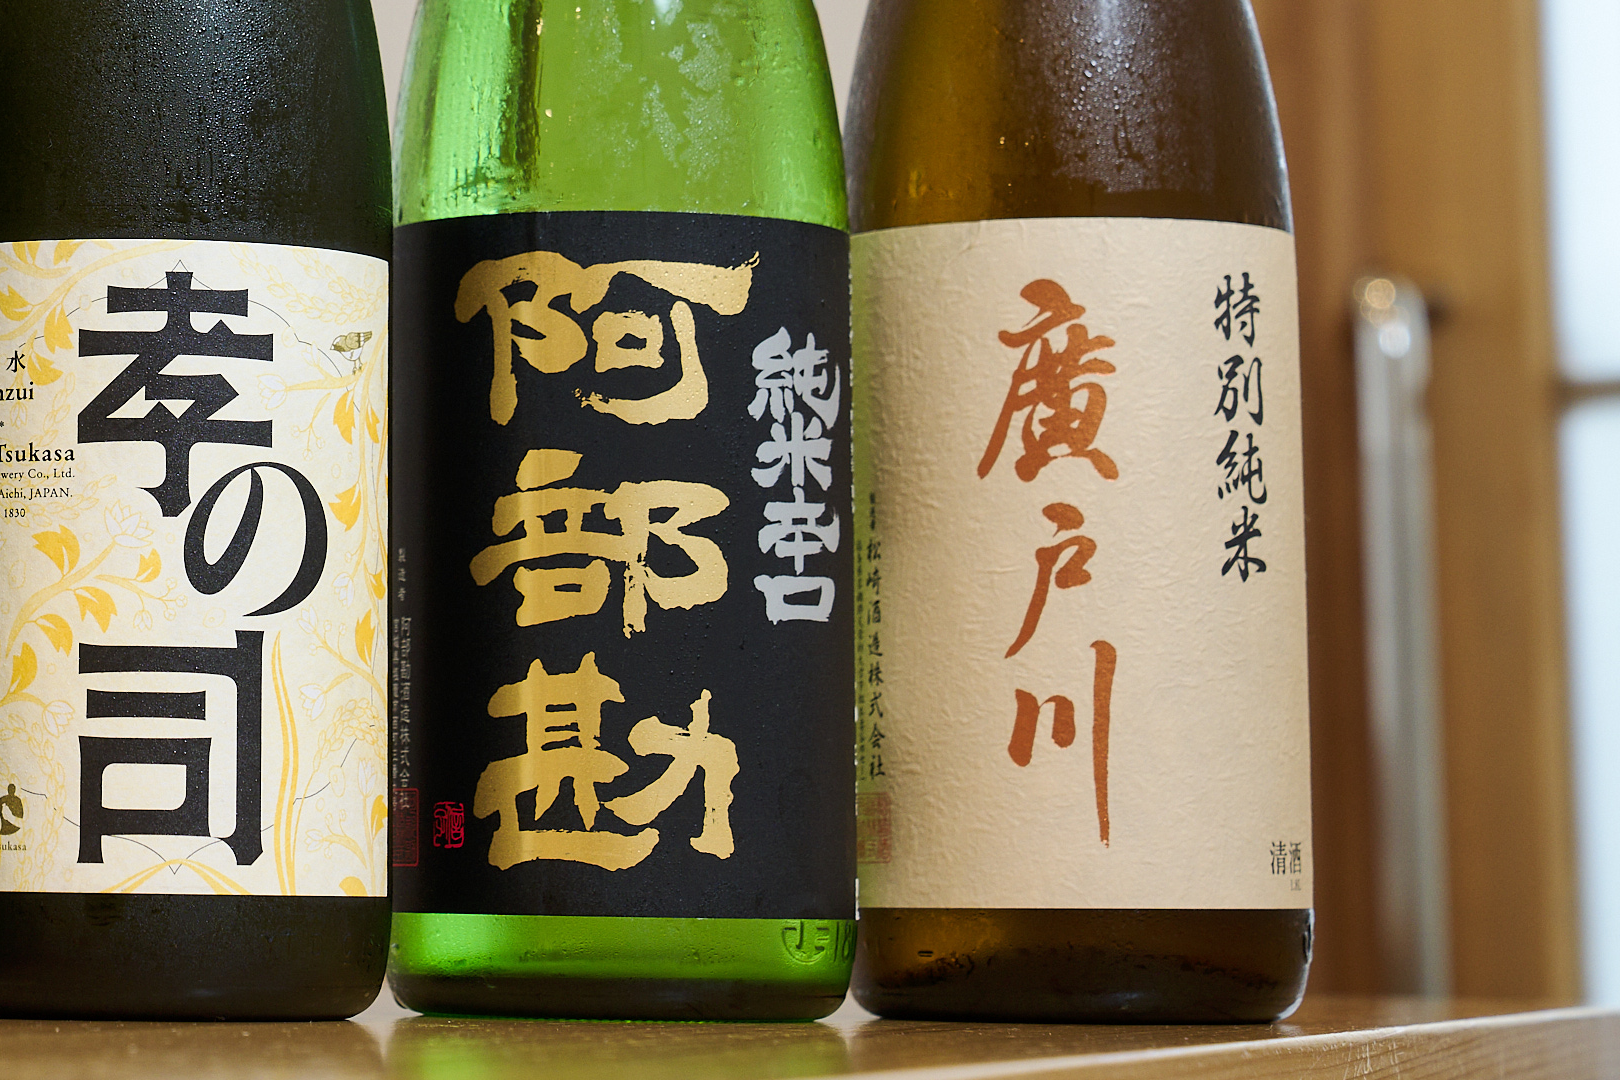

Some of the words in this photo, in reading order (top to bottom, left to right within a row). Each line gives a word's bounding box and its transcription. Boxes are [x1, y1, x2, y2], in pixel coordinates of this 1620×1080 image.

[4, 508, 26, 519] 1830
[28, 468, 50, 480] Co.,
[53, 468, 76, 479] Ltd.
[29, 487, 73, 500] JAPAN.
[455, 250, 761, 872] 阿部勘
[747, 326, 841, 625] 純米辛口
[1214, 272, 1268, 582] 特別純米
[77, 271, 328, 866] 孝の司
[865, 538, 887, 780] 松崎酒造株式会社
[977, 278, 1119, 848] 廣戸川
[1269, 840, 1302, 875] 清酒
